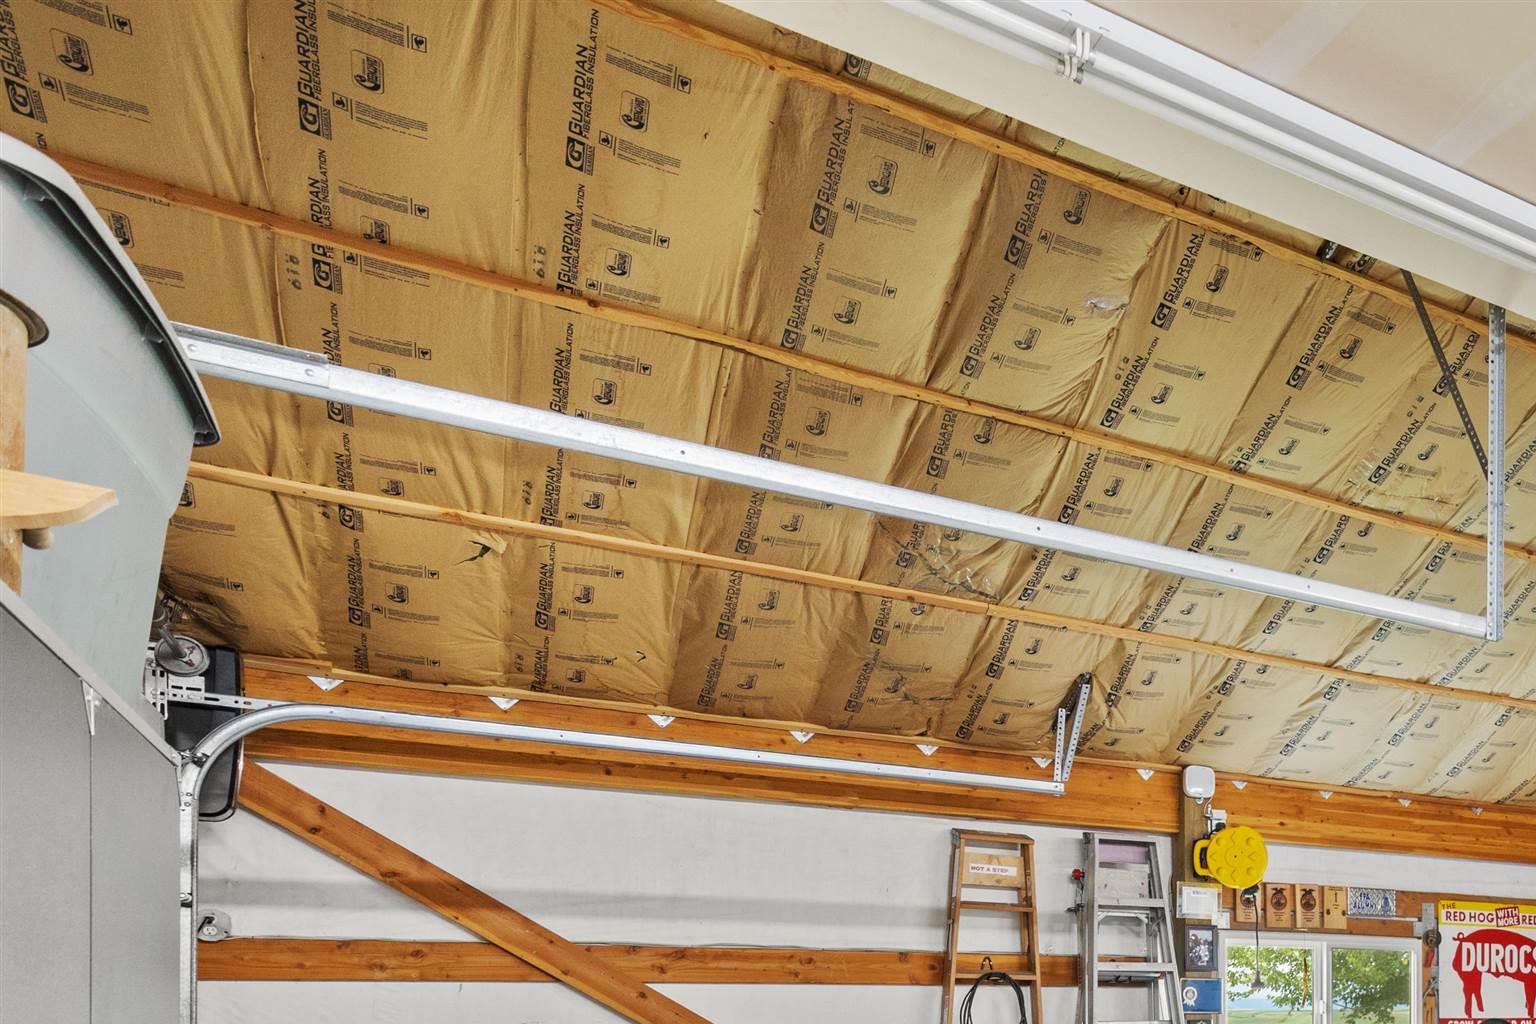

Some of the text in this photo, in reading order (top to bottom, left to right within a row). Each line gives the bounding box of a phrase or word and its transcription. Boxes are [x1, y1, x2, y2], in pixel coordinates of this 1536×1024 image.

[587, 8, 600, 75] INSULATION
[568, 43, 589, 137] GUARDIAN
[581, 75, 594, 139] FIBERGLASS
[840, 100, 856, 147] INSULAT
[318, 148, 330, 203] INSULATION
[817, 117, 846, 203] GUARDIAN
[1015, 169, 1044, 235] GUARDI
[557, 210, 576, 285] GUARDIAN
[569, 183, 586, 286] FIBERGLASS INSULATION
[806, 241, 825, 289] INSULATION
[1163, 233, 1199, 304] GUARDIAN
[786, 265, 812, 330] GUARDIAN
[968, 294, 1001, 356] GUARDIAN
[1299, 305, 1339, 367] GUARDIAN
[550, 347, 567, 413] GUARDIAN
[1111, 354, 1145, 410] GUARDIAN
[762, 379, 785, 445] GUARDIAN
[1240, 413, 1277, 463] GUARDIAN
[1381, 419, 1420, 467] GUARDIAN
[542, 465, 558, 517] GUARDIAN
[1066, 452, 1095, 505] GUARDIAN
[740, 491, 760, 539] GUARDIAN
[1192, 502, 1222, 553] GUARDIAN
[536, 562, 551, 613] GUARDIAN
[1148, 589, 1175, 628] GUARDIAN
[992, 619, 1016, 663] GUARDIAN
[1111, 653, 1134, 694] GUARDIAN
[1442, 902, 1456, 910] THE
[1445, 910, 1495, 923] RED HOG
[1497, 907, 1519, 918] WITH
[1497, 916, 1520, 927] MORE
